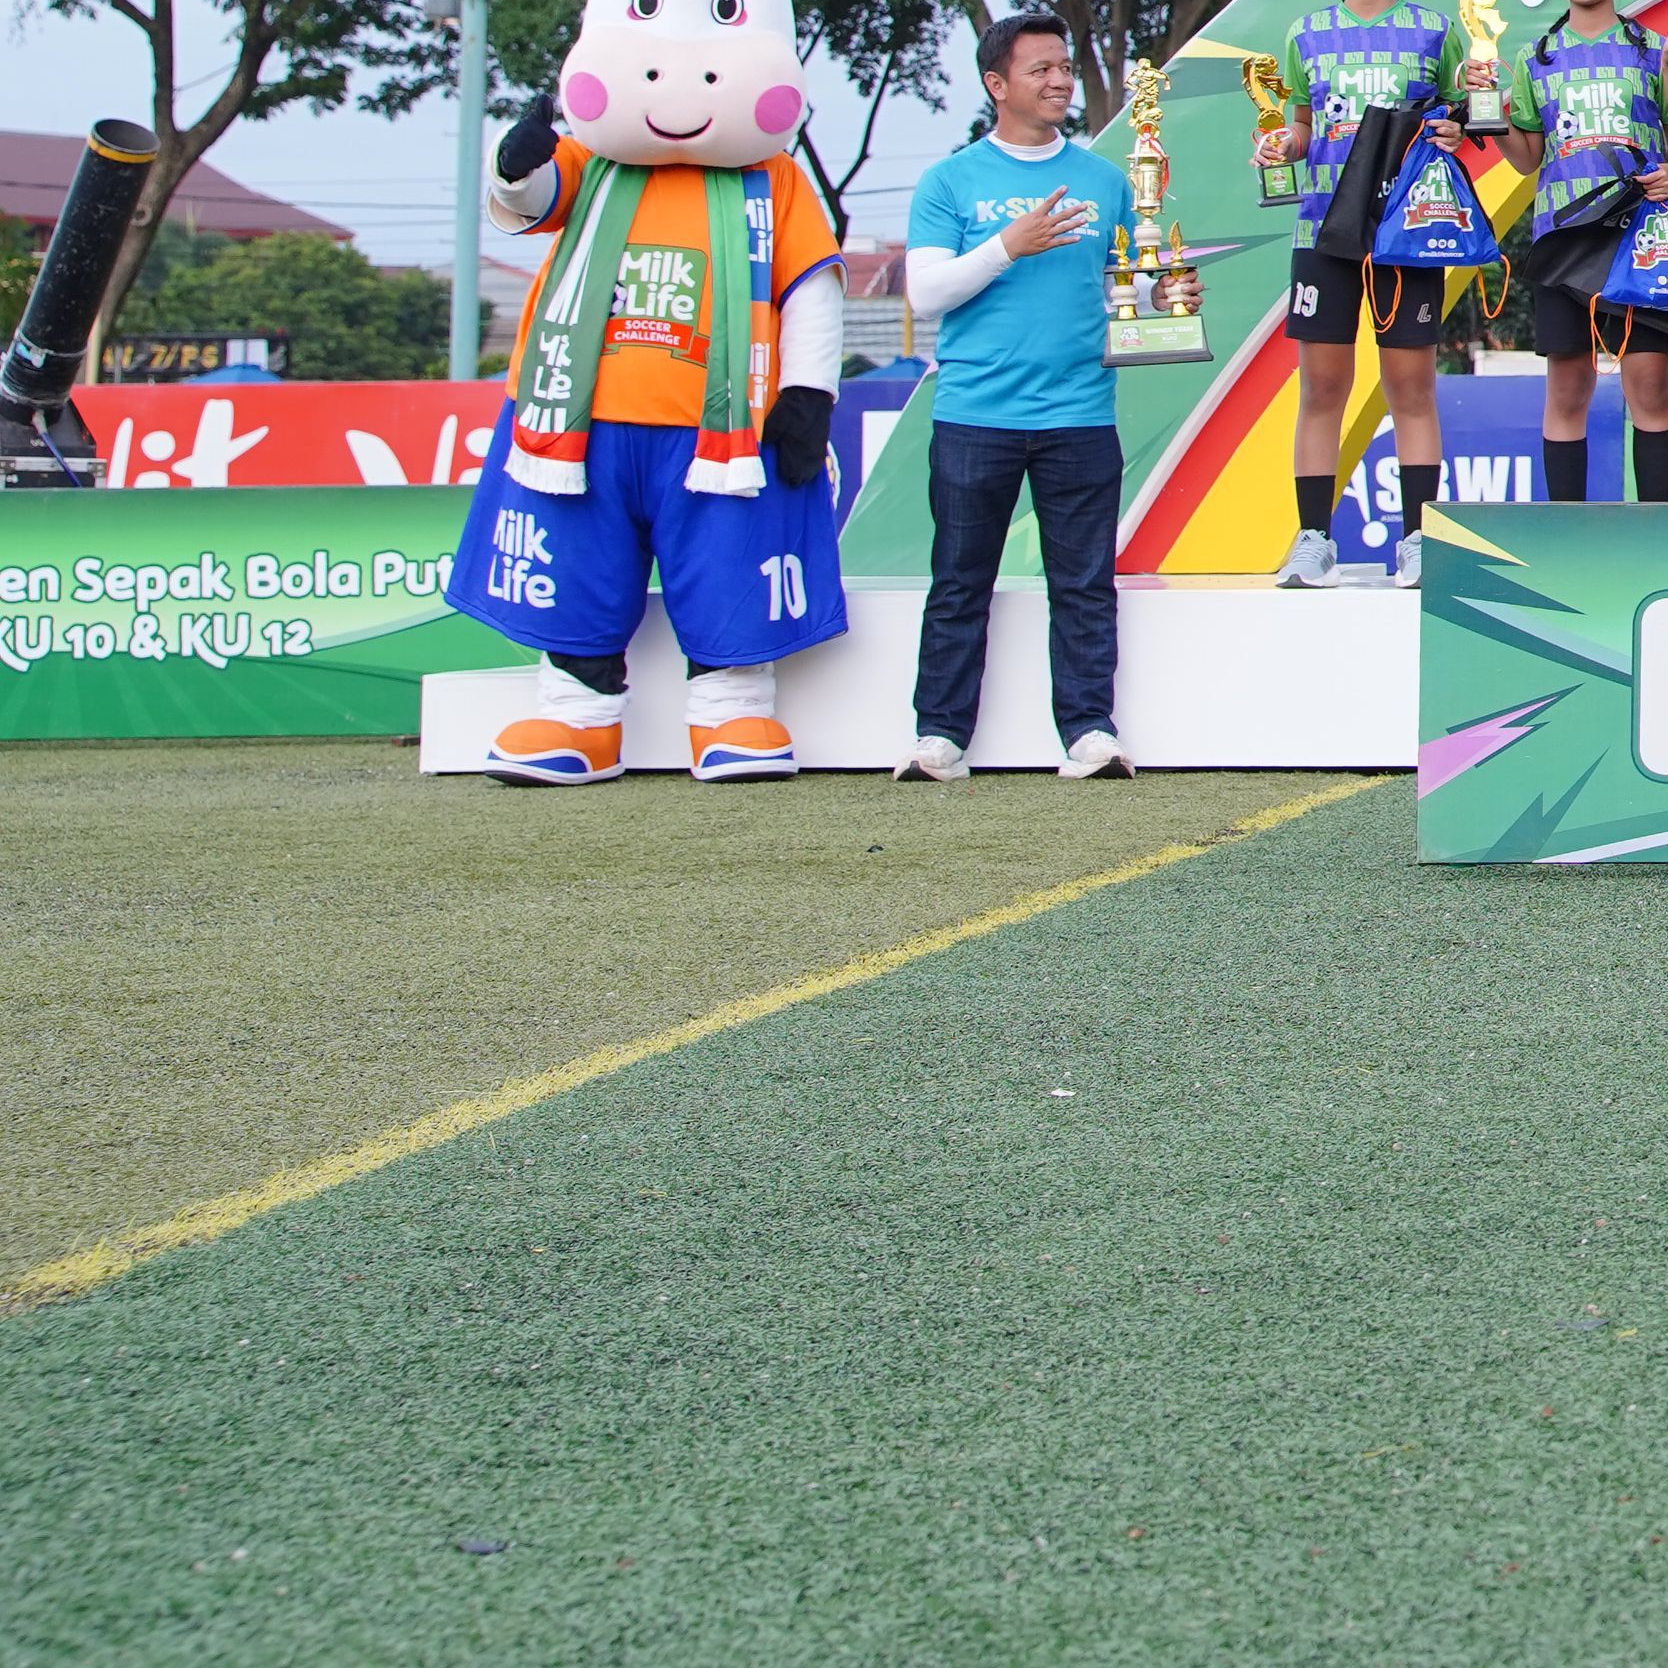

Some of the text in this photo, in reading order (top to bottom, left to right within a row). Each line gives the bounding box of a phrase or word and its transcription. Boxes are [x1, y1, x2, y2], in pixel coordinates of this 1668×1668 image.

[1339, 68, 1401, 95] Milk
[1566, 82, 1625, 110] Milk
[1579, 108, 1630, 136] Life
[1570, 138, 1594, 148] SOCCER
[618, 250, 695, 288] Milk
[624, 284, 695, 320] Life
[1292, 281, 1319, 317] 19
[614, 331, 680, 346] CHALLENGE
[624, 319, 671, 333] SOCCER
[73, 551, 235, 612] Sepak
[246, 550, 361, 598] Bola
[372, 550, 455, 598] Put
[487, 554, 557, 609] Life
[760, 554, 807, 621] 10
[64, 621, 117, 659] 10
[129, 612, 166, 661] &
[180, 613, 251, 670] KU
[262, 619, 314, 658] 12
